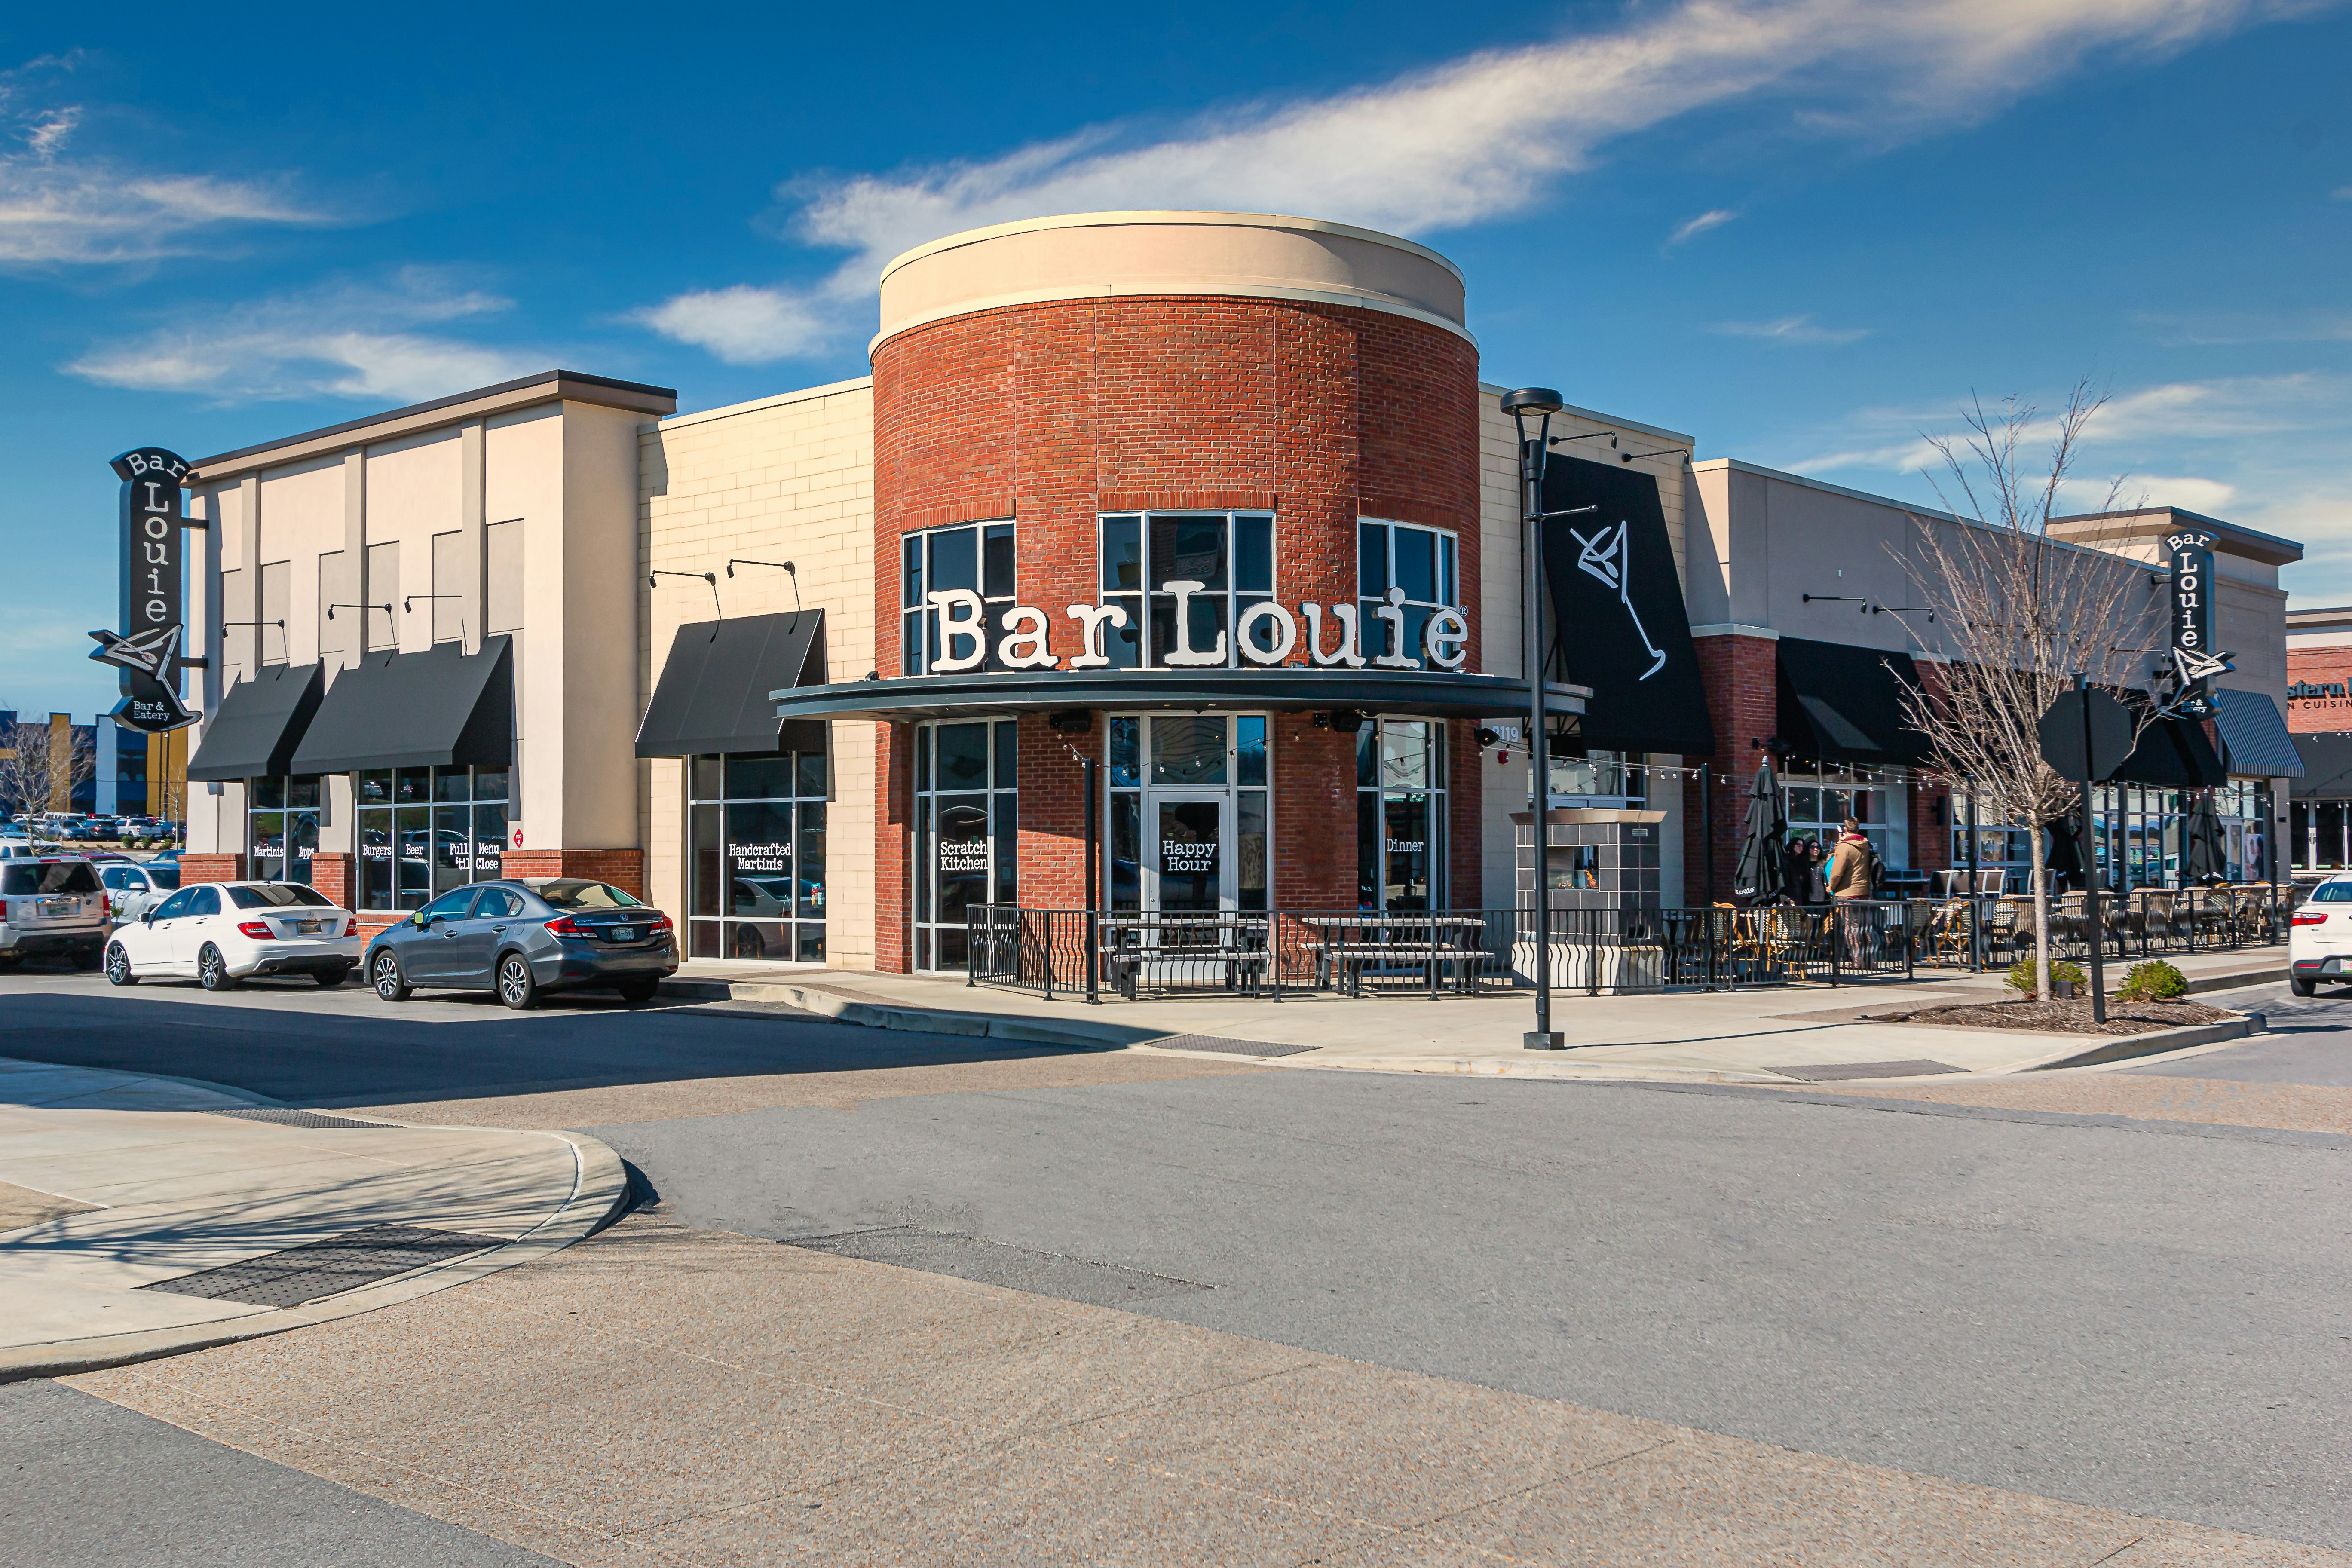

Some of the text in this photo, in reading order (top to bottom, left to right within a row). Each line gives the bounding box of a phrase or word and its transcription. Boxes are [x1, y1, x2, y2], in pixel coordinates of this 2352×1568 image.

[126, 453, 186, 622] Bar Louie
[2167, 534, 2210, 646] Bar Louie
[928, 588, 1128, 672] Bar
[134, 701, 164, 710] Bar &
[134, 710, 170, 722] Eatery
[254, 846, 284, 857] Martinis
[362, 844, 392, 858] Burgers
[406, 844, 423, 855] Beer
[450, 842, 500, 855] Full Menu
[729, 843, 791, 856] Handcrafted
[940, 840, 988, 855] Scratch
[1162, 840, 1216, 858] Happy
[1387, 838, 1424, 852] Dinner
[299, 845, 315, 860] Apps
[475, 858, 499, 870] Close
[738, 857, 783, 870] Martinis
[940, 855, 988, 870] Kitchen
[1167, 857, 1211, 871] Hour
